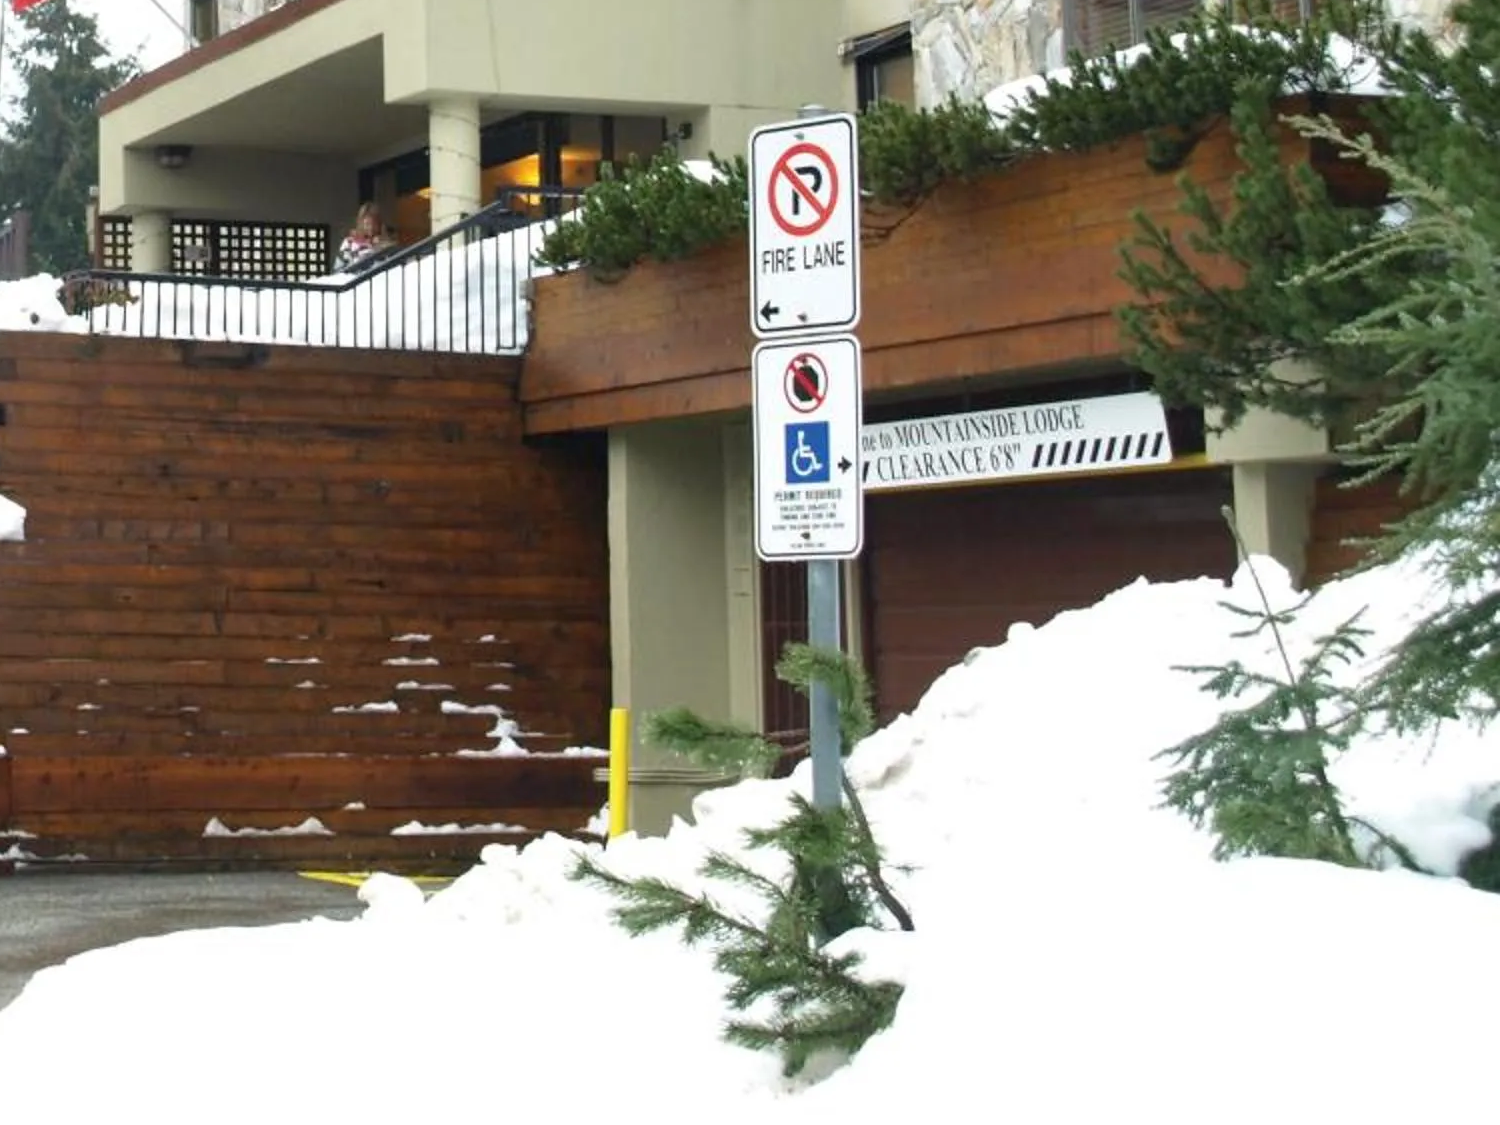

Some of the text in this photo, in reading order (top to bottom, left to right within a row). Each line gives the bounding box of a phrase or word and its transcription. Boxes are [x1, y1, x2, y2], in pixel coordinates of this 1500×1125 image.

[762, 241, 845, 274] FIRE LANE
[894, 412, 1021, 449] MOUNTAINSIDE
[1023, 405, 1085, 435] LODGE
[877, 446, 987, 481] CLEARANCE
